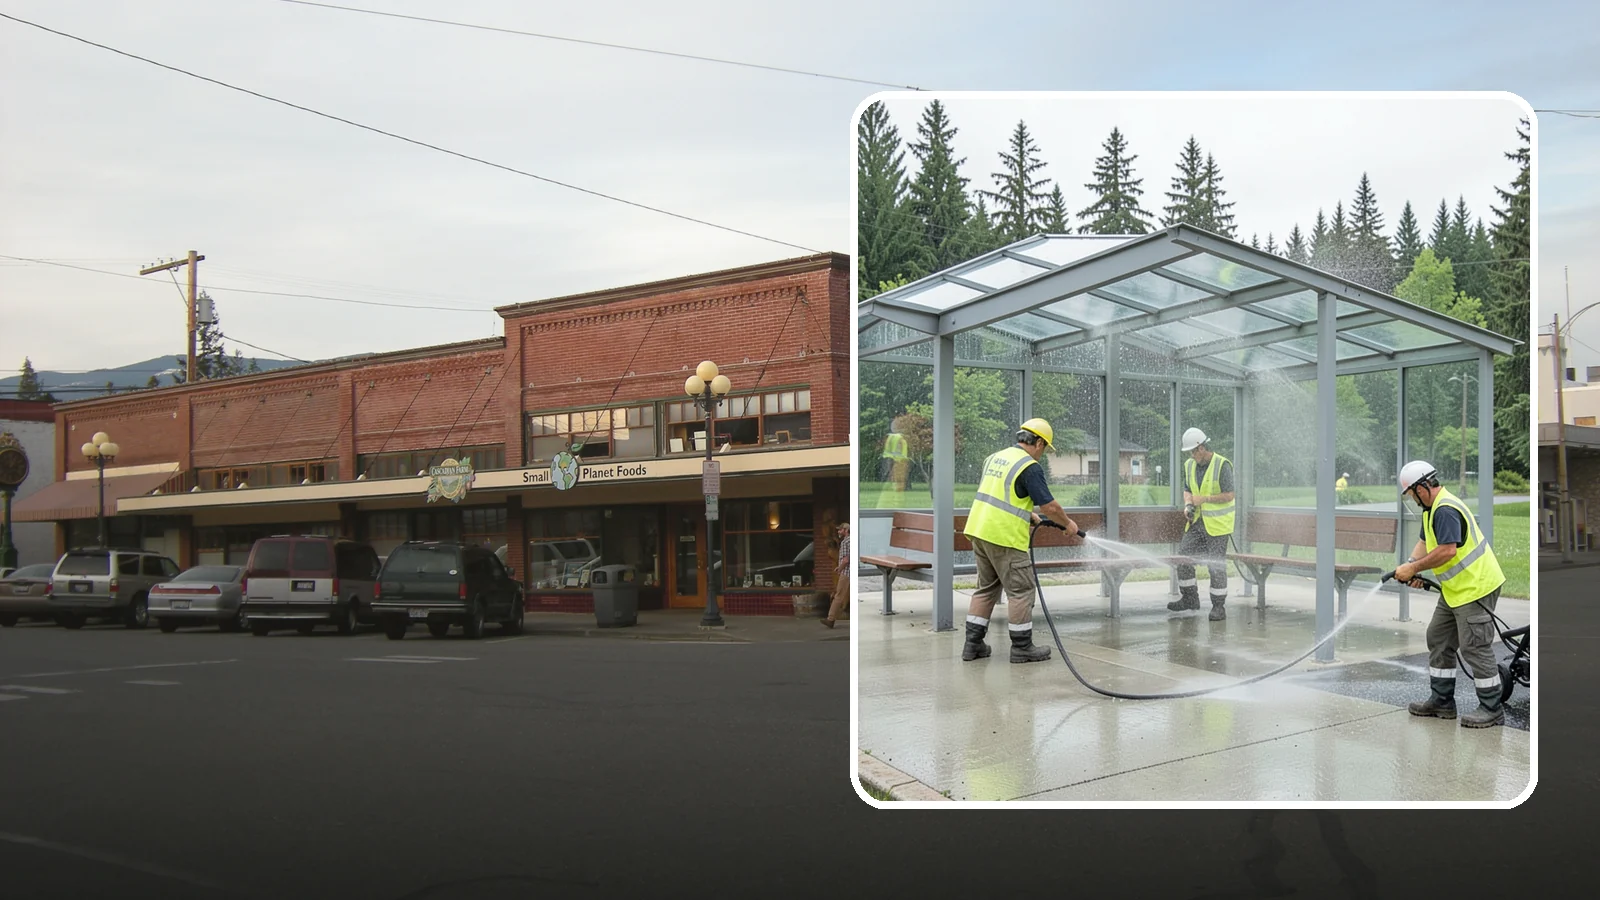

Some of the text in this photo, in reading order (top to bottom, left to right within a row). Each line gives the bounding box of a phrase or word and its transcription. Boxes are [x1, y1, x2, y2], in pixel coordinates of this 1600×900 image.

[523, 464, 647, 483] Small Planet Foods
